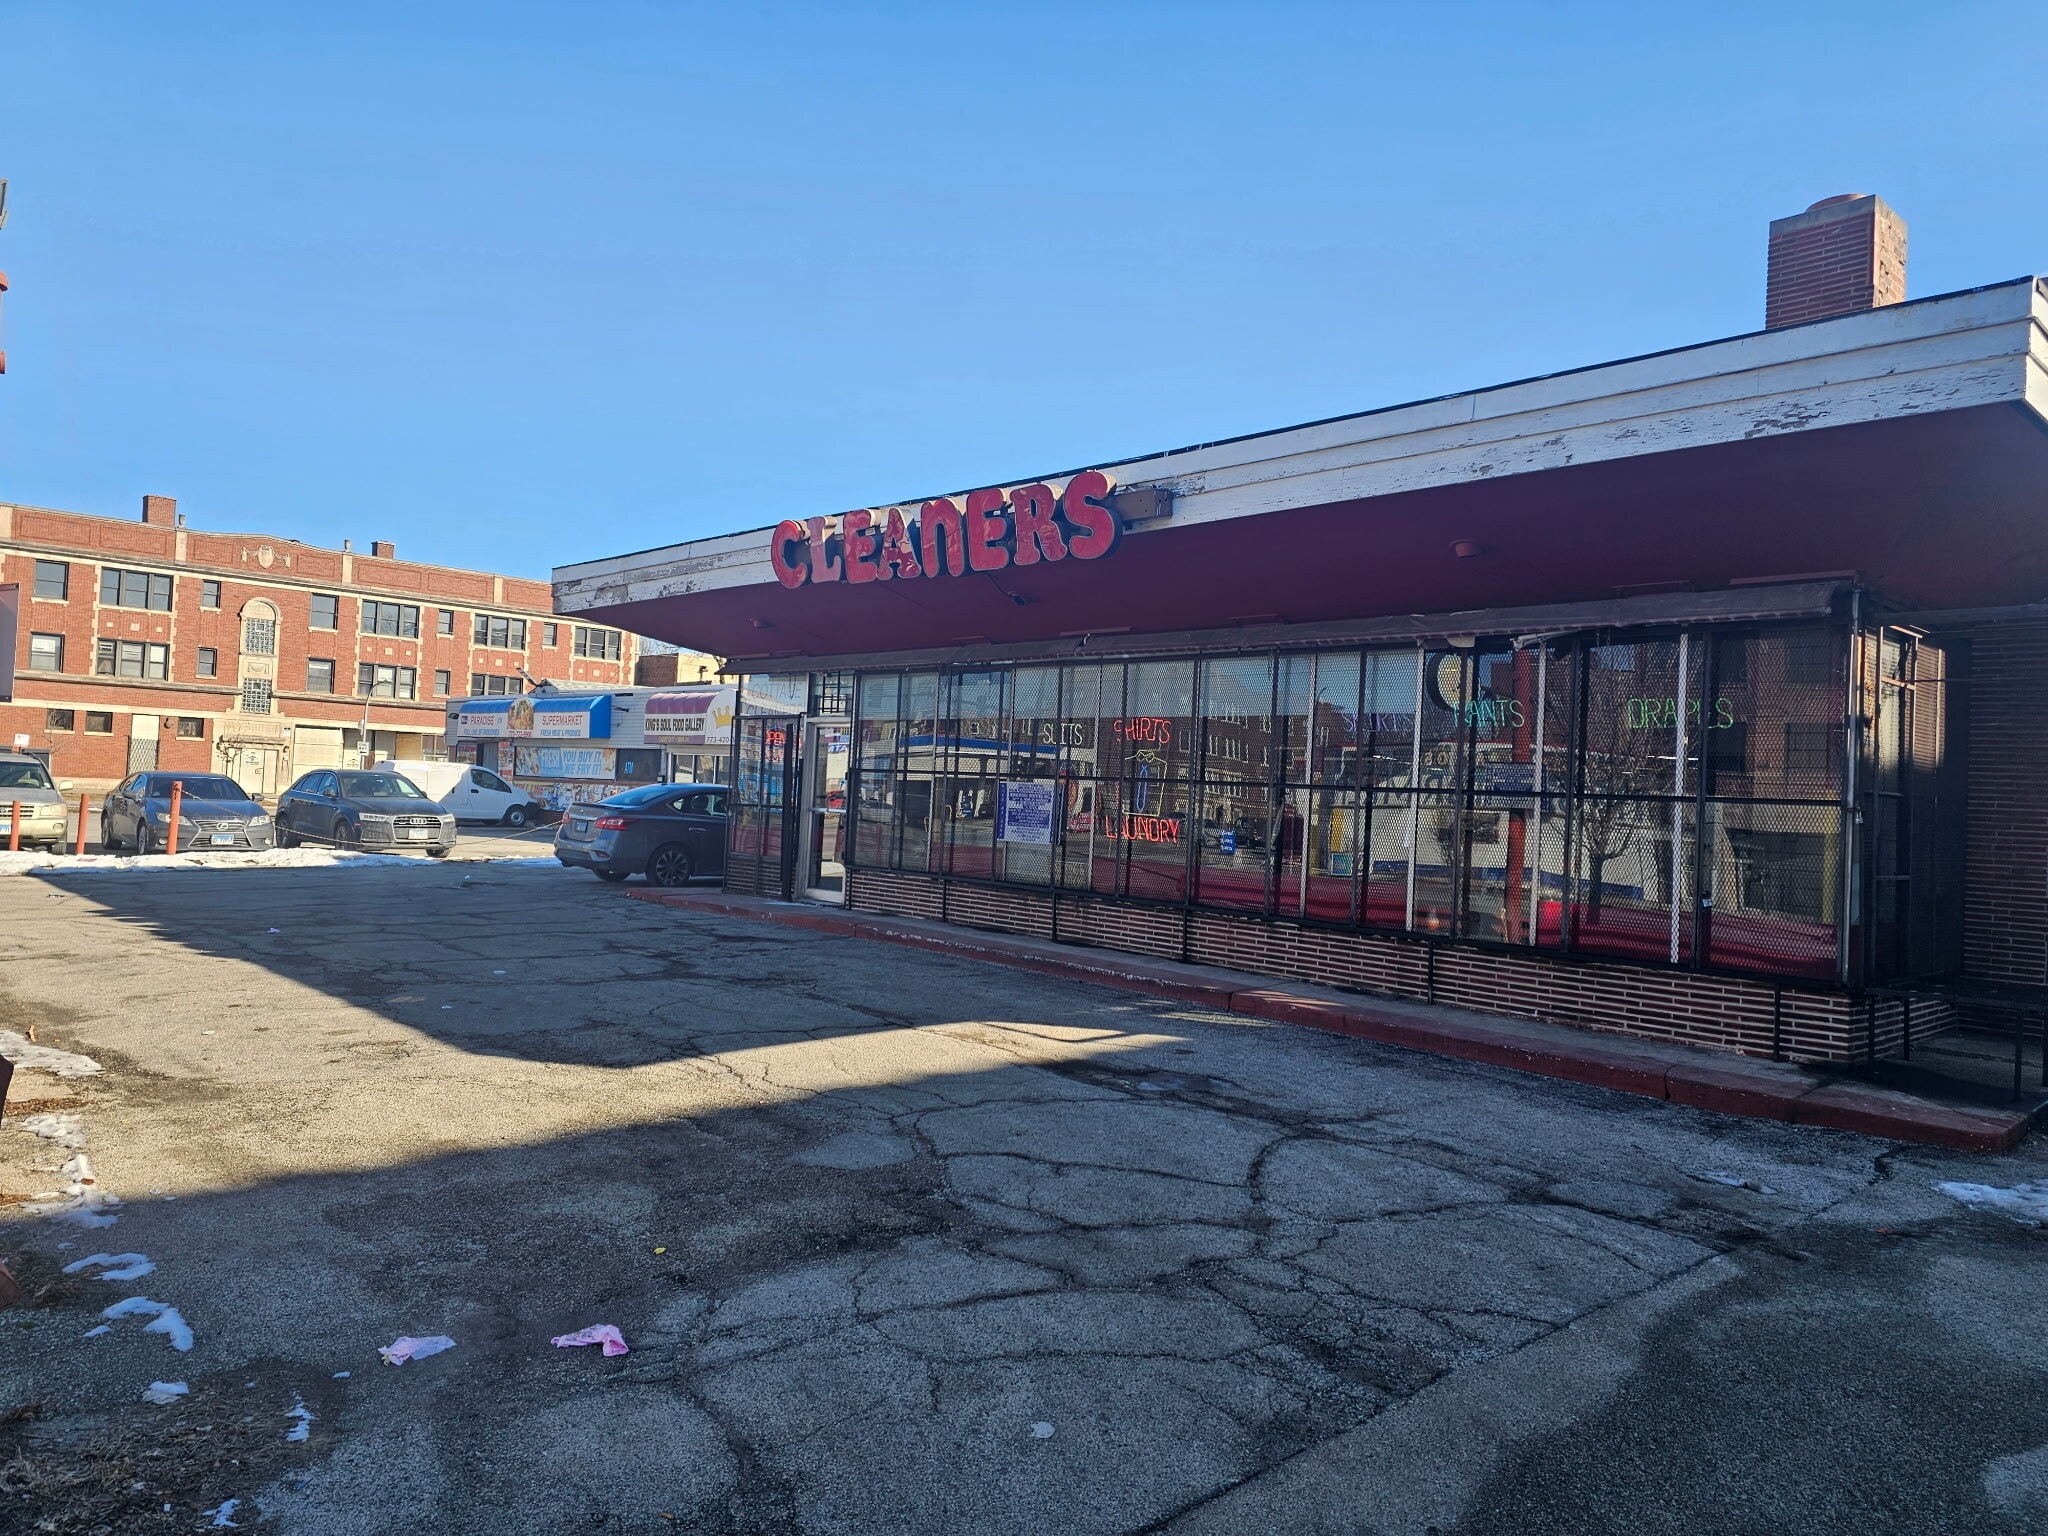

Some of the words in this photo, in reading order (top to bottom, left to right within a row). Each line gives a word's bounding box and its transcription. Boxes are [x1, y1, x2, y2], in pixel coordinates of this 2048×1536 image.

[771, 470, 1115, 588] CLEANERS
[470, 715, 495, 726] PARADISE
[542, 714, 583, 726] SUPERMARKET
[645, 718, 660, 731] KING'S
[660, 718, 671, 731] SOUL
[672, 718, 684, 731] FOOD
[684, 717, 705, 731] GALLERY
[1113, 717, 1171, 744] SHIRTS
[563, 751, 577, 763] YOU
[578, 751, 593, 763] BUY
[564, 763, 576, 775] WE
[577, 764, 591, 775] FRY
[1105, 815, 1180, 844] LAUNDRY
